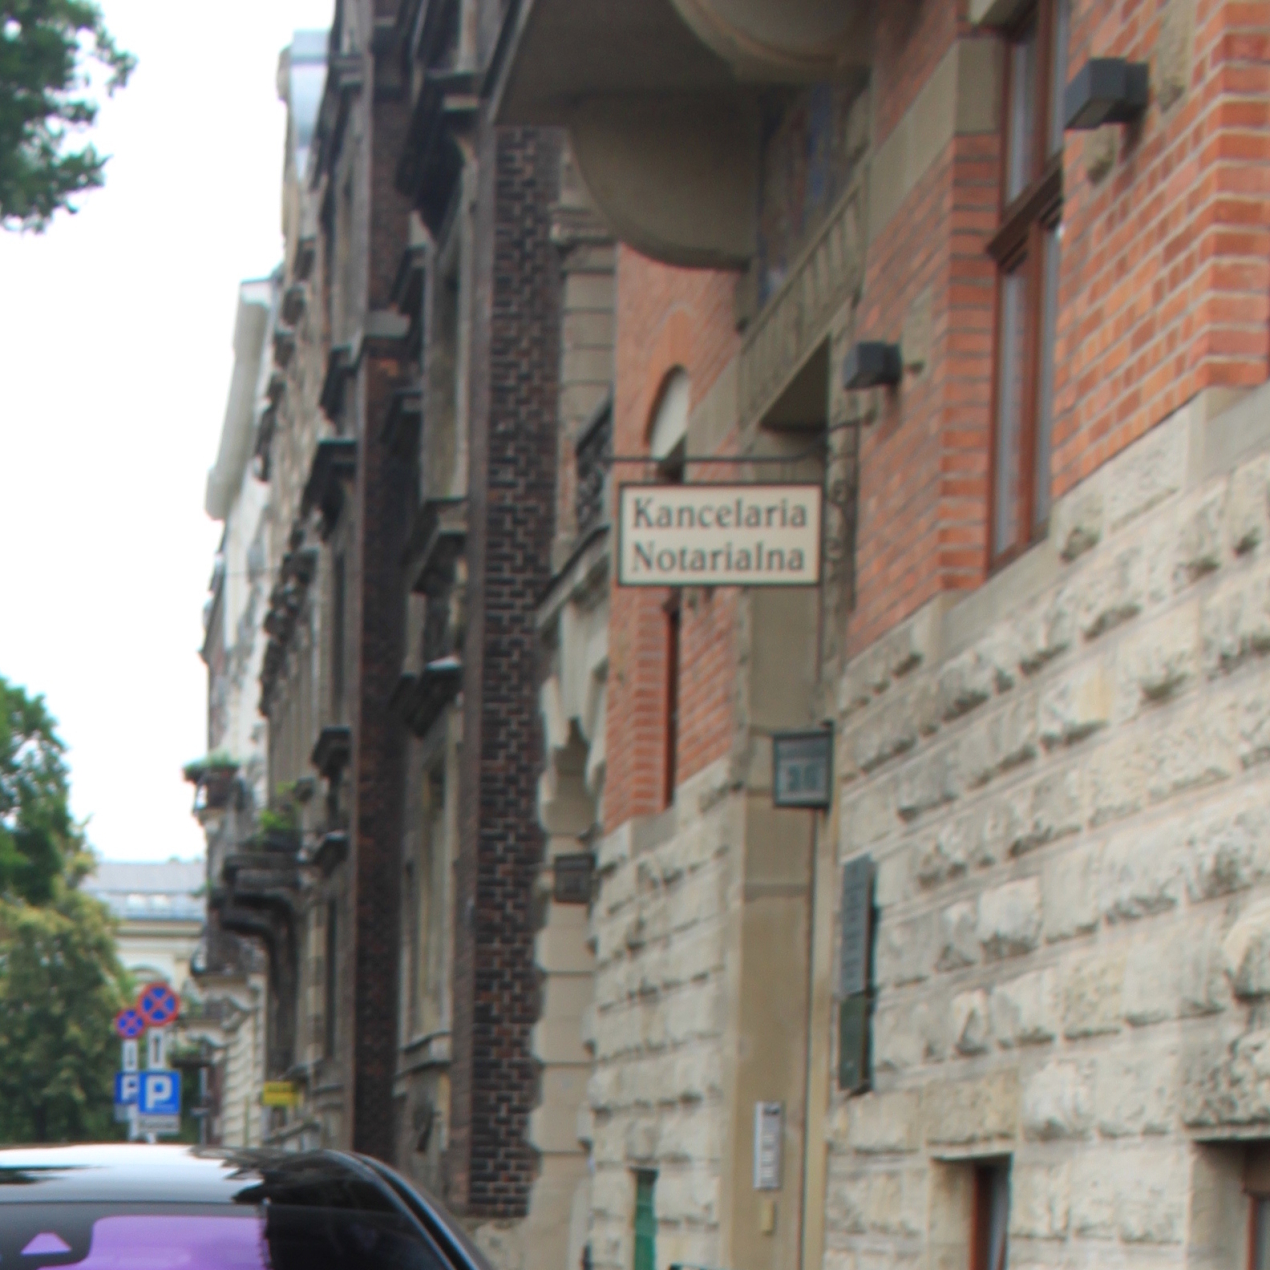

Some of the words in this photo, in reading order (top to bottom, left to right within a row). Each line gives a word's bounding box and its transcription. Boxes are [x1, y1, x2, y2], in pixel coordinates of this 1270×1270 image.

[633, 497, 807, 529] Kancelaria
[632, 540, 805, 572] Notarialna
[145, 1075, 172, 1109] P
